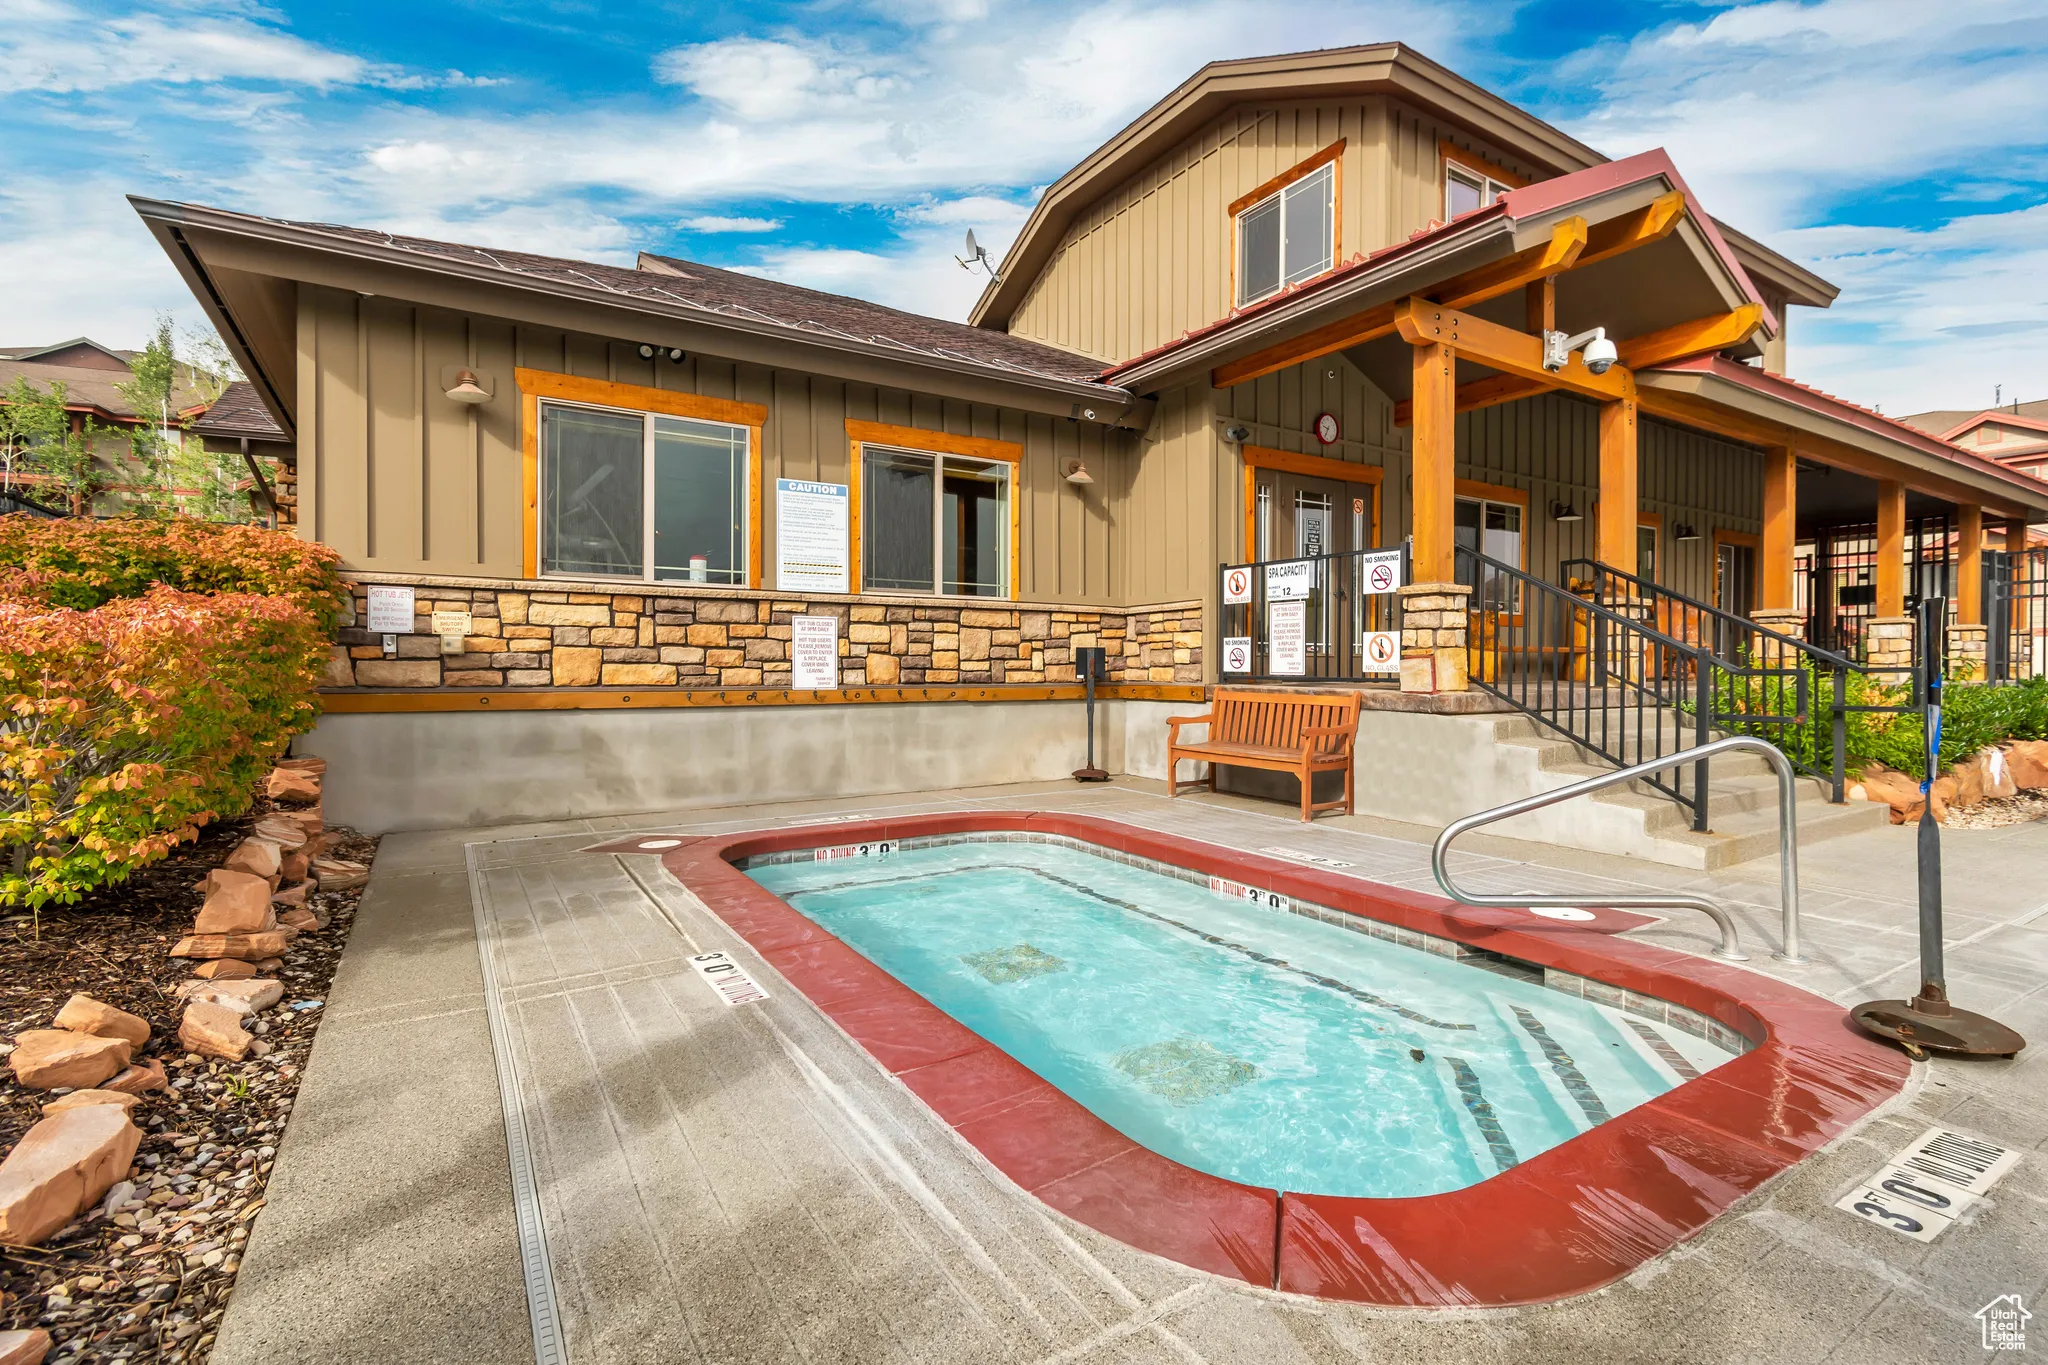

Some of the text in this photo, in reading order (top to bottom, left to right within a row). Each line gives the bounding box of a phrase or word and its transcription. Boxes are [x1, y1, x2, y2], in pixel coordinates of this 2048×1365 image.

[788, 482, 837, 494] CAUTION
[1374, 554, 1398, 563] SMOKING
[1269, 564, 1308, 578] SPA CAPACITY
[1283, 587, 1291, 595] 12
[816, 850, 828, 860] NO
[831, 846, 856, 860] DIVING
[860, 846, 868, 854] 3
[880, 843, 889, 853] 0
[1210, 878, 1287, 907] NO DIVING 3 FT 0 IN
[704, 964, 734, 973] 0
[1904, 1132, 2006, 1187] NO DIVING
[1882, 1170, 1951, 1208] 0 IN
[1854, 1191, 1923, 1232] 3 FT
